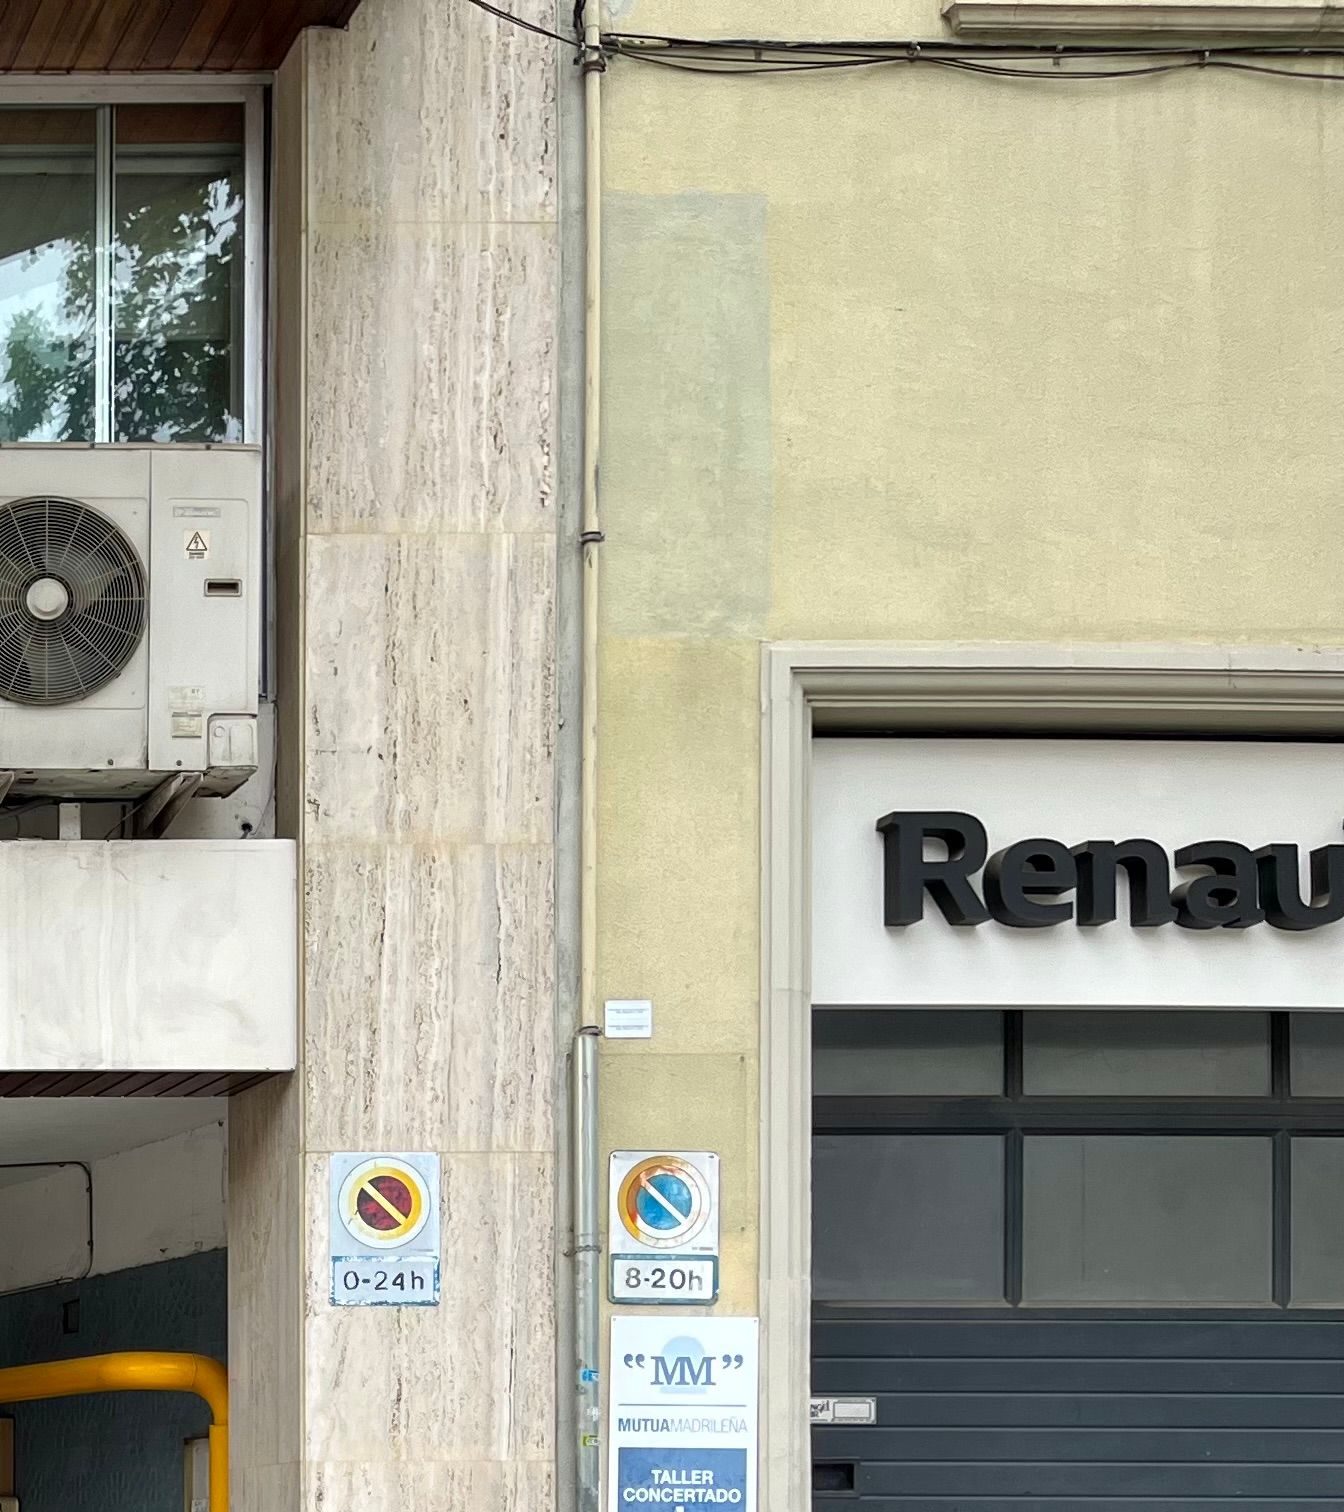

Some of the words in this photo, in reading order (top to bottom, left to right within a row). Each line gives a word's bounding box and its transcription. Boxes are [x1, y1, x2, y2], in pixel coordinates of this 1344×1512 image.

[343, 1270, 424, 1291] 0-24h
[625, 1267, 703, 1290] 8-20h
[651, 1469, 714, 1485] TALLER
[622, 1487, 742, 1503] CONCERTADO
